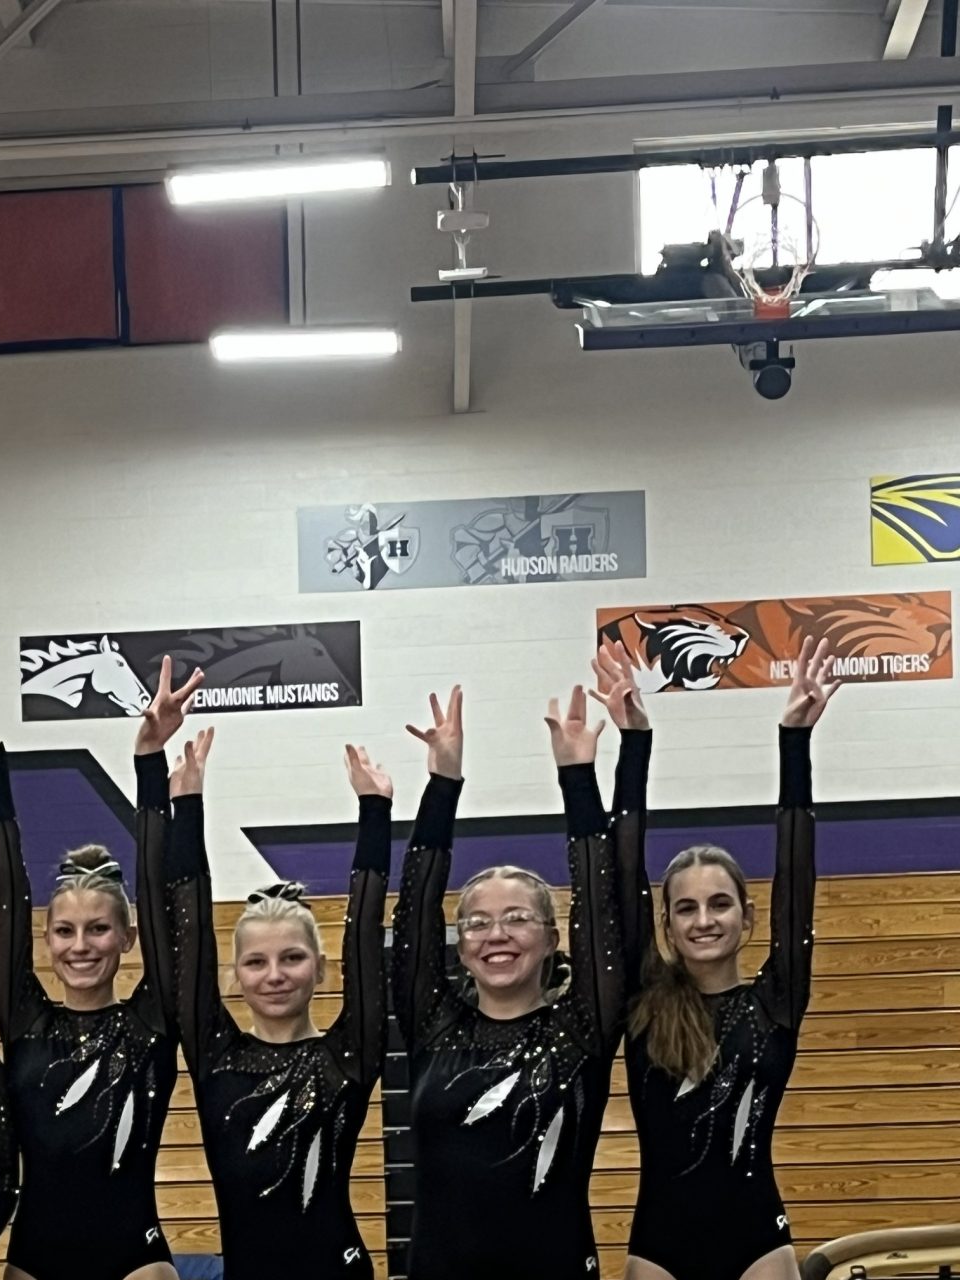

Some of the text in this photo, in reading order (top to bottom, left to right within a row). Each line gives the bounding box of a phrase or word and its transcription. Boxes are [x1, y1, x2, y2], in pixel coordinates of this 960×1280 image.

[501, 553, 618, 577] HUDSON RAIDERS
[881, 653, 930, 675] TIGERS
[193, 682, 339, 708] ENOMONIE MUSTANGS
